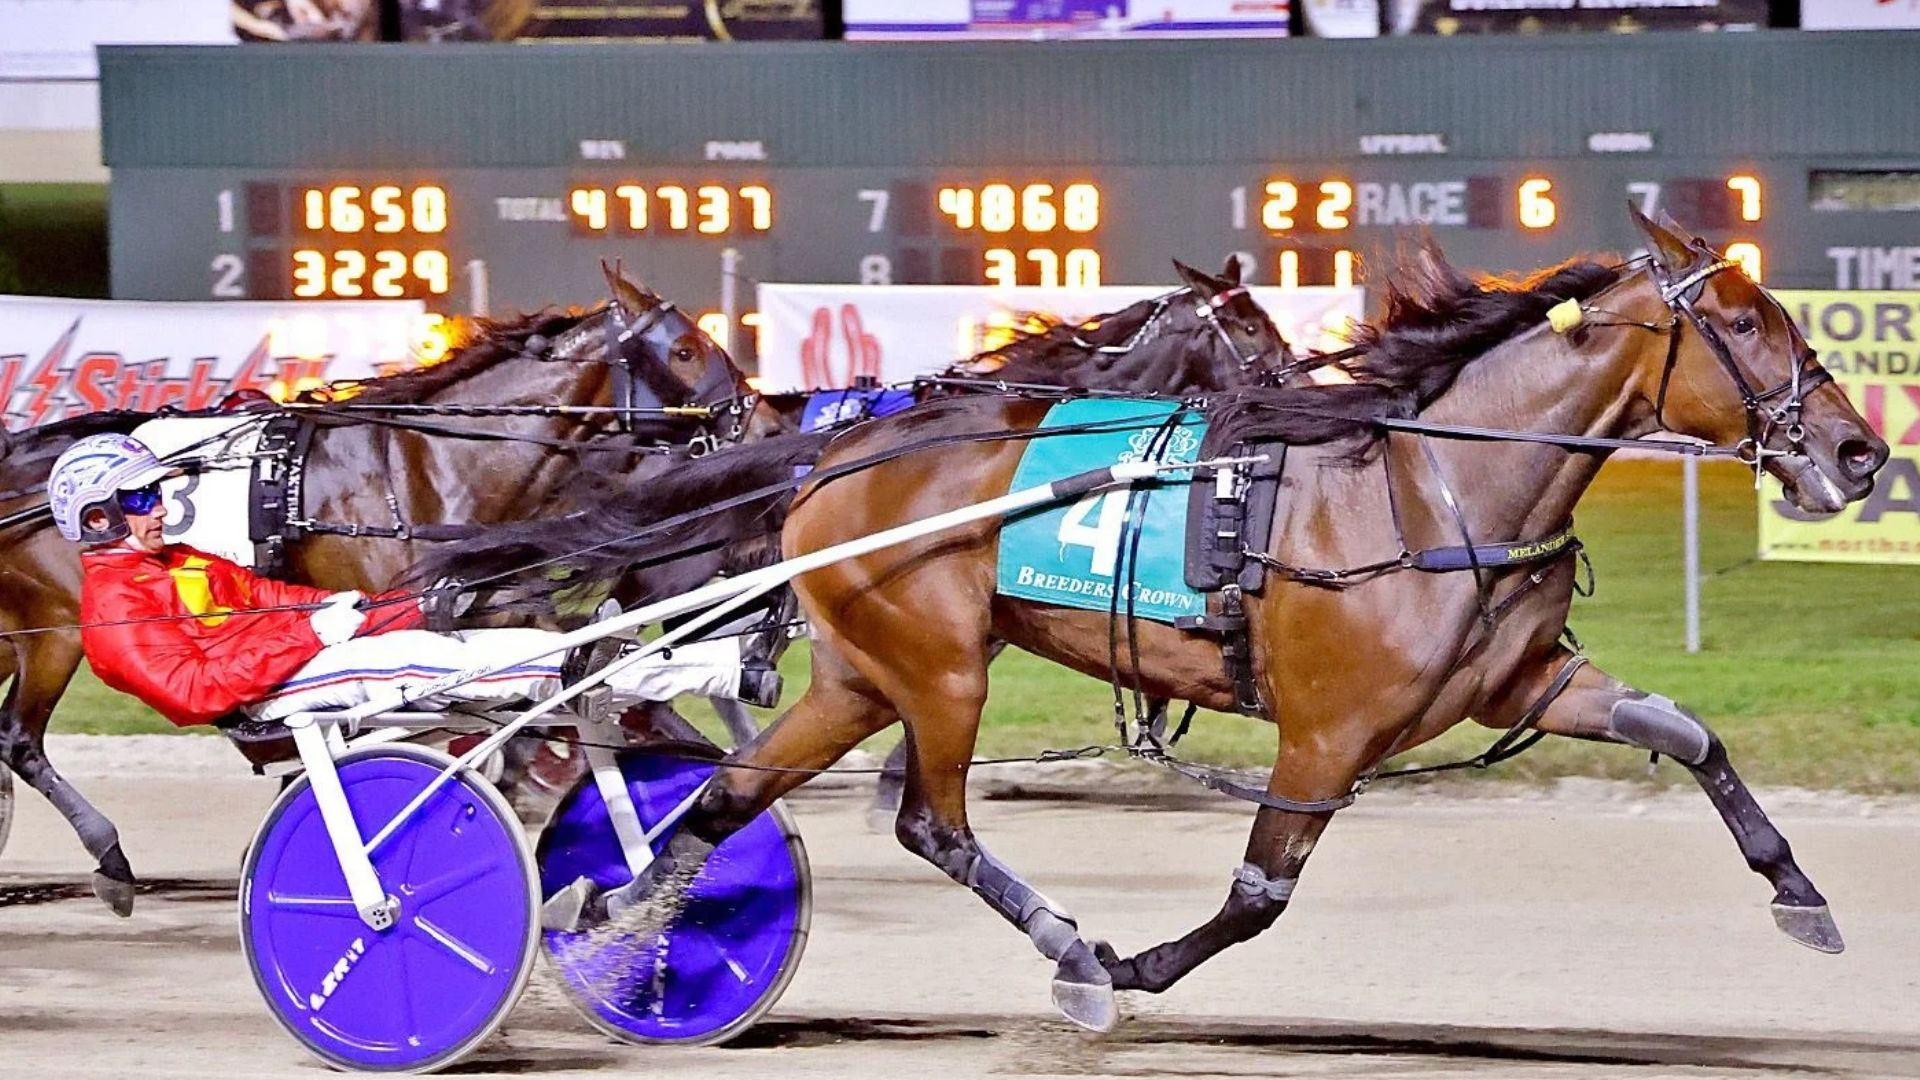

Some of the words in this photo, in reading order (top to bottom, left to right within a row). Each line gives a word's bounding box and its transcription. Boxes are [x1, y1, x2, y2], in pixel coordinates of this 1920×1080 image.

[218, 189, 234, 233] 1
[305, 186, 447, 233] 1650
[571, 186, 772, 234] 47737
[857, 189, 890, 232] 7
[1230, 185, 1247, 230] 1
[1356, 181, 1468, 226] RACE
[1518, 178, 1557, 229] 6
[1727, 176, 1761, 222] 7
[211, 254, 244, 297] 2
[293, 250, 448, 297] 3229
[1826, 246, 1920, 289] TIME
[1057, 482, 1136, 577] 4
[1016, 565, 1115, 598] BREEDERS
[1121, 581, 1193, 610] CROWN
